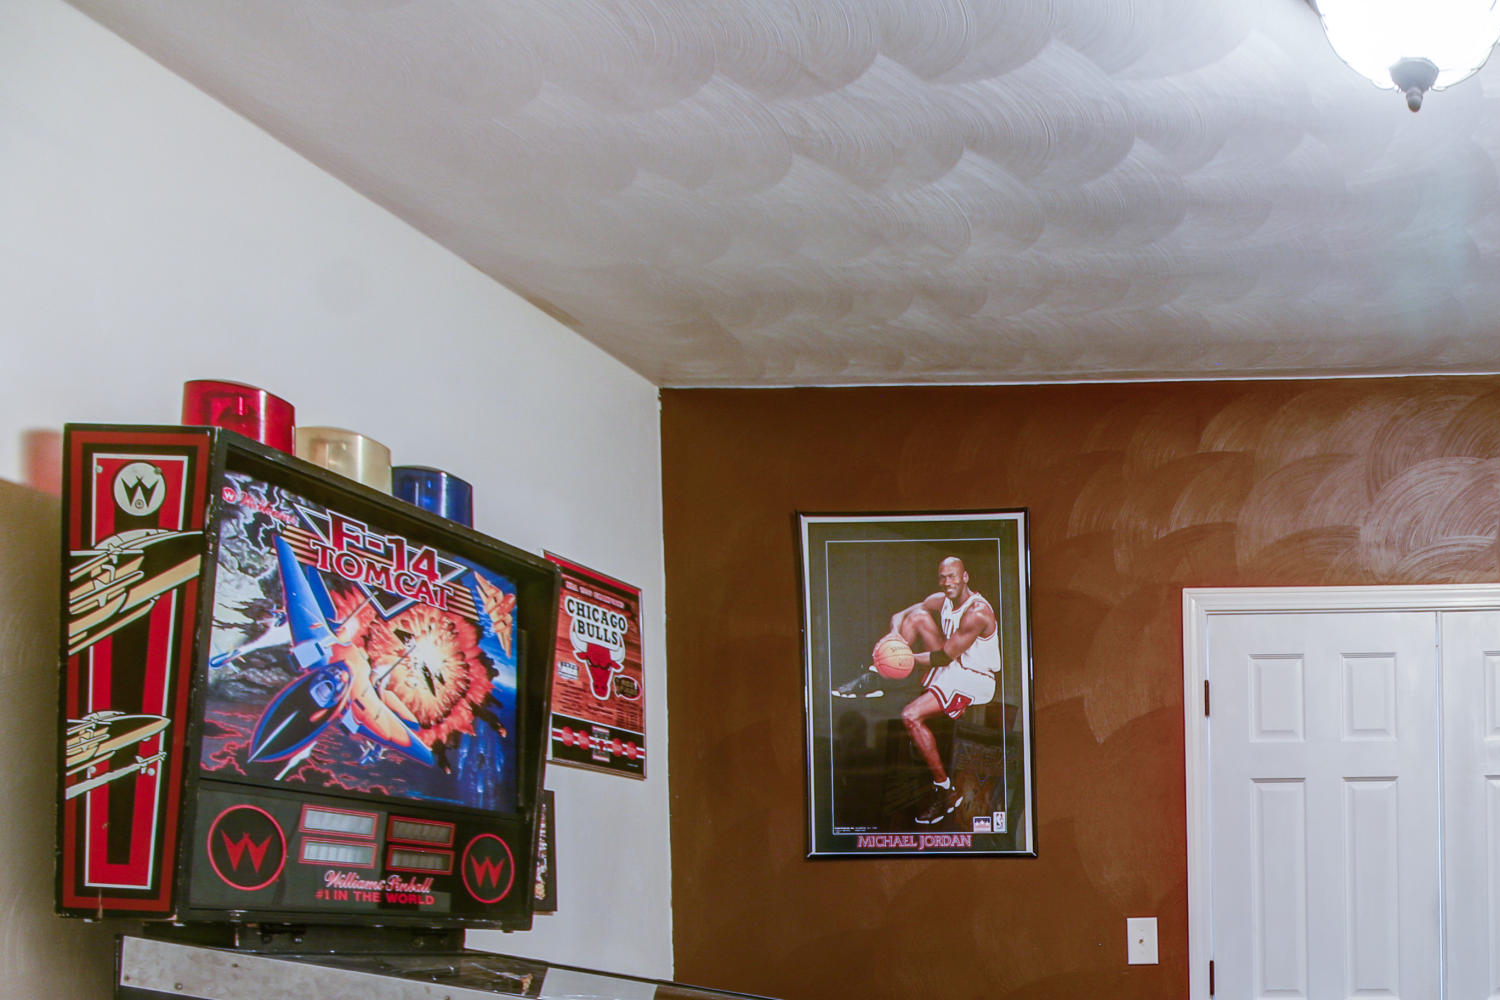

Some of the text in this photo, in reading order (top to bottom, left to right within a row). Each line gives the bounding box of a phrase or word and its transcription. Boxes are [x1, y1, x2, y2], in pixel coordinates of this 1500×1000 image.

[326, 509, 440, 585] F-14
[310, 539, 454, 610] TOMCAT
[566, 598, 627, 632] CHICAGO
[577, 619, 618, 645] BULLS
[857, 834, 973, 850] MICHAEL JORDAN
[324, 869, 434, 894] Williams Pinball
[315, 889, 435, 905] #1 IN THE WORLD
